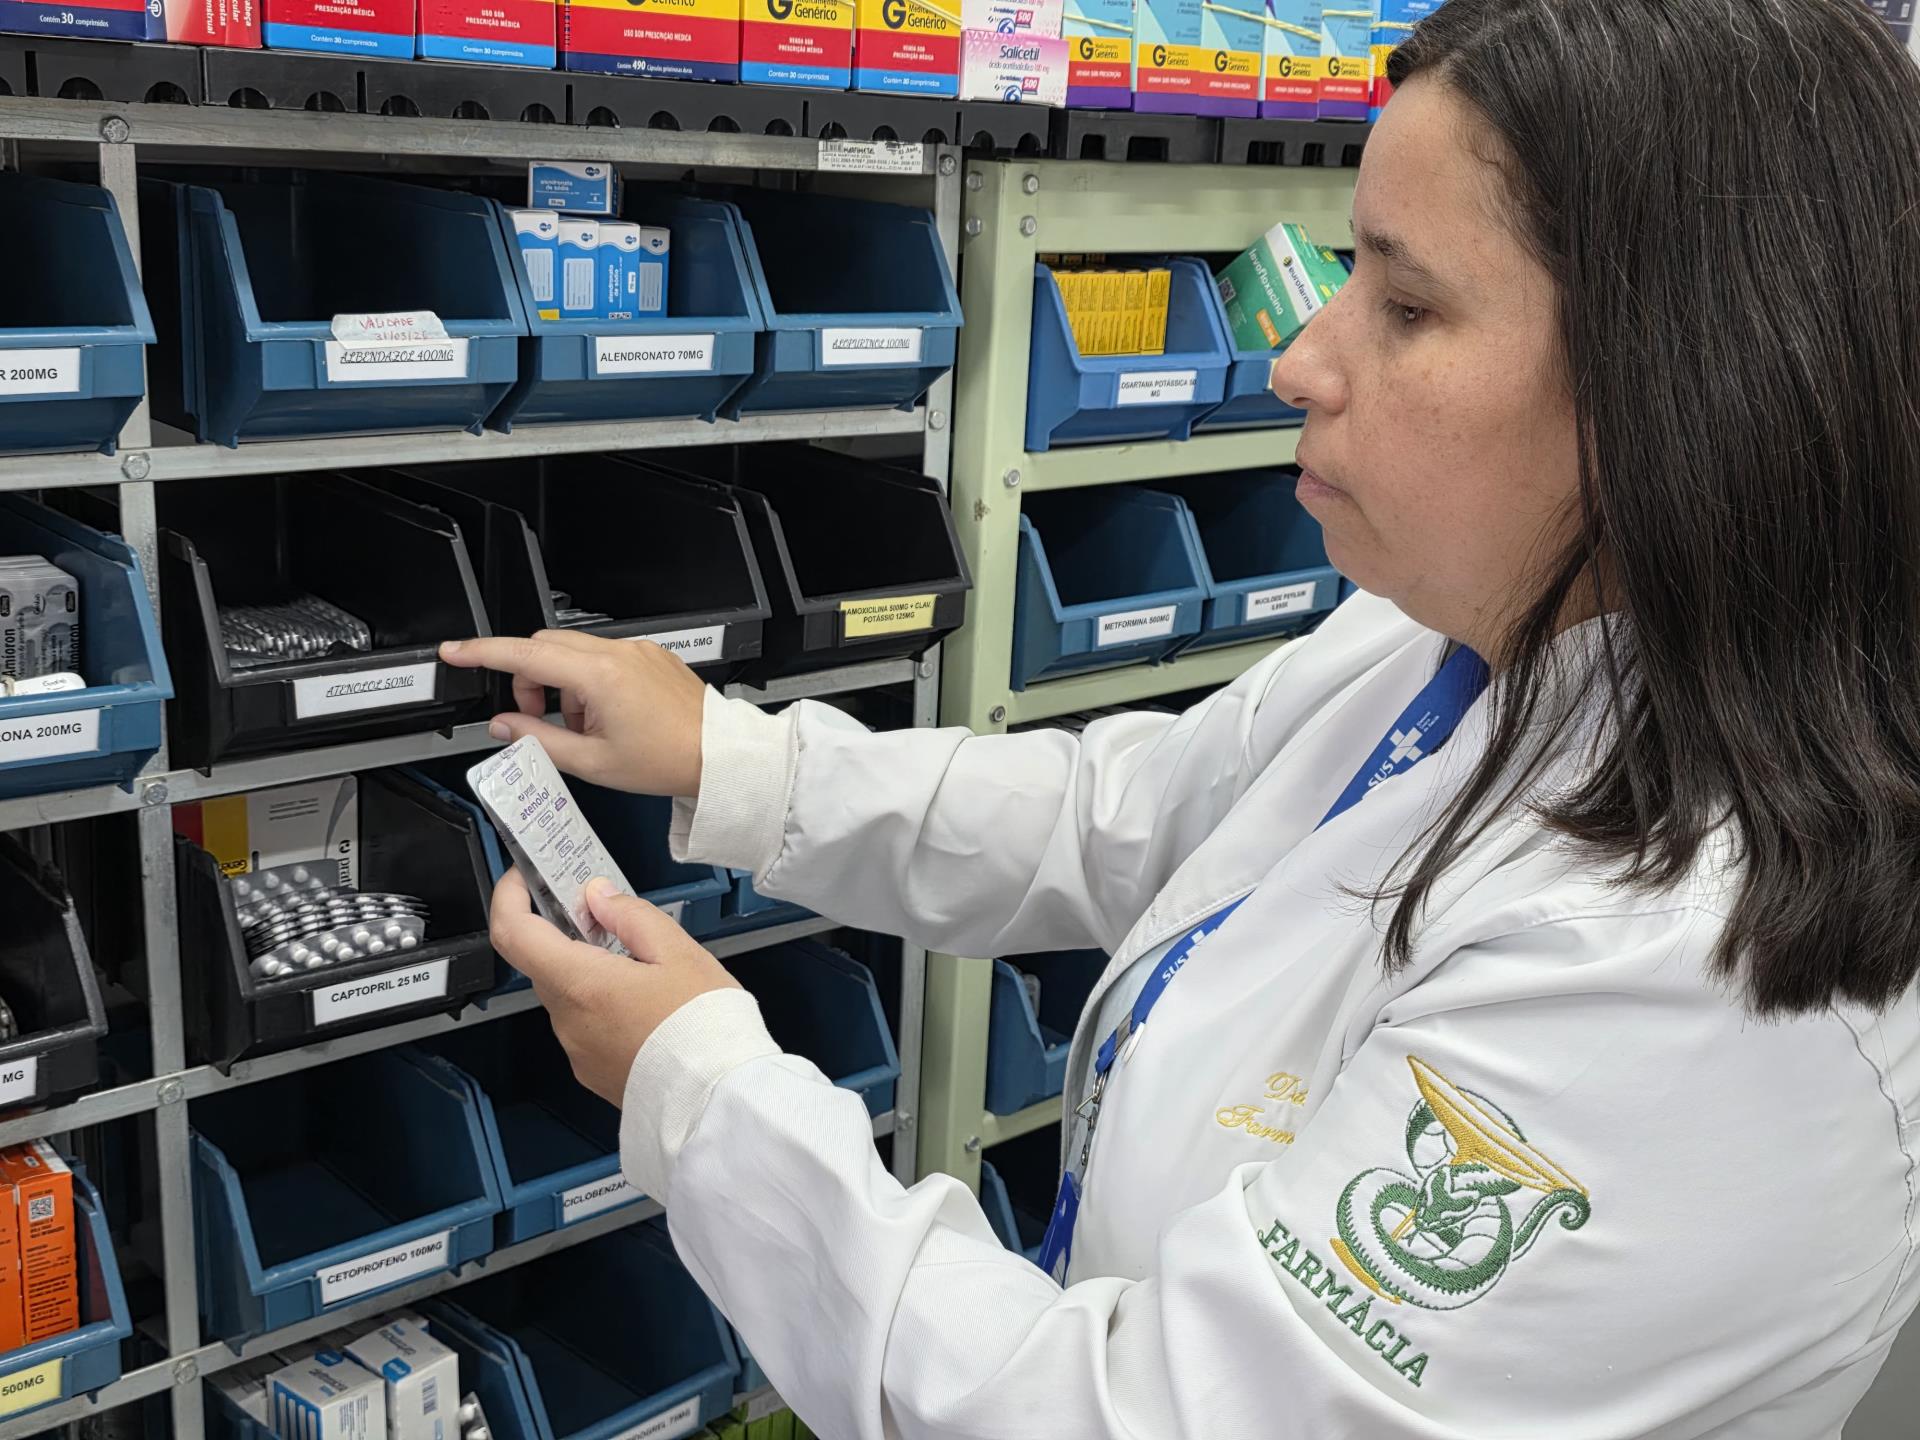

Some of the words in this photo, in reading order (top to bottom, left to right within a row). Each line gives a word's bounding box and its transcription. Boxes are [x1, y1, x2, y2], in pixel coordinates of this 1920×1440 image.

[61, 12, 74, 24] 30
[244, 0, 253, 27] abeça
[315, 4, 351, 15] PRESCRIÇÃO
[353, 8, 375, 17] MÉDICA
[482, 9, 492, 17] USO
[494, 10, 504, 18] SOB
[795, 4, 837, 21] Genérico
[466, 17, 499, 26] PRESCRIÇÃO
[501, 19, 520, 29] MÉDICA
[908, 13, 947, 30] Genérico
[311, 34, 333, 42] Contém
[343, 38, 378, 47] comprimidos
[624, 29, 634, 37] USO
[635, 30, 644, 38] SOB
[645, 30, 673, 42] PRESCRIÇÃO
[999, 45, 1040, 61] Salicetil
[632, 60, 646, 71] 490
[768, 70, 788, 78] Contém
[1024, 79, 1038, 89] 500
[1248, 248, 1284, 316] levofloxacino
[1289, 268, 1313, 311] eurofarma
[359, 316, 414, 330] VALIDADE
[339, 350, 414, 364] ALBENDAZOL
[417, 349, 454, 362] 400MG
[600, 351, 675, 362] ALENDRONATO
[678, 350, 704, 360] 70MG
[10, 368, 58, 380] 200MG
[847, 606, 888, 616] AMOXICILINA
[889, 603, 908, 612] 500MG
[915, 601, 931, 610] CLAV.
[863, 614, 894, 624] POTÁSSIO
[896, 612, 915, 620] 125MG
[1104, 619, 1148, 632] METFORMINA
[1149, 613, 1170, 625] 500MG
[693, 636, 713, 647] 5MG
[326, 680, 380, 698] ATENOLOL
[383, 675, 414, 689] 50MG
[36, 723, 82, 738] 200MG
[1367, 760, 1394, 788] SUS
[524, 782, 537, 799] prati
[520, 786, 550, 820] atenolol
[1162, 955, 1187, 983] SUS
[331, 980, 395, 1003] CAPTOPRIL
[397, 976, 410, 987] 25
[412, 971, 430, 984] MG
[2, 1070, 25, 1084] MG
[327, 1252, 408, 1285] CETOPROFENO
[410, 1241, 443, 1259] 100MG
[1258, 1218, 1429, 1388] FARMÁCIA
[2, 1374, 45, 1397] 500MG
